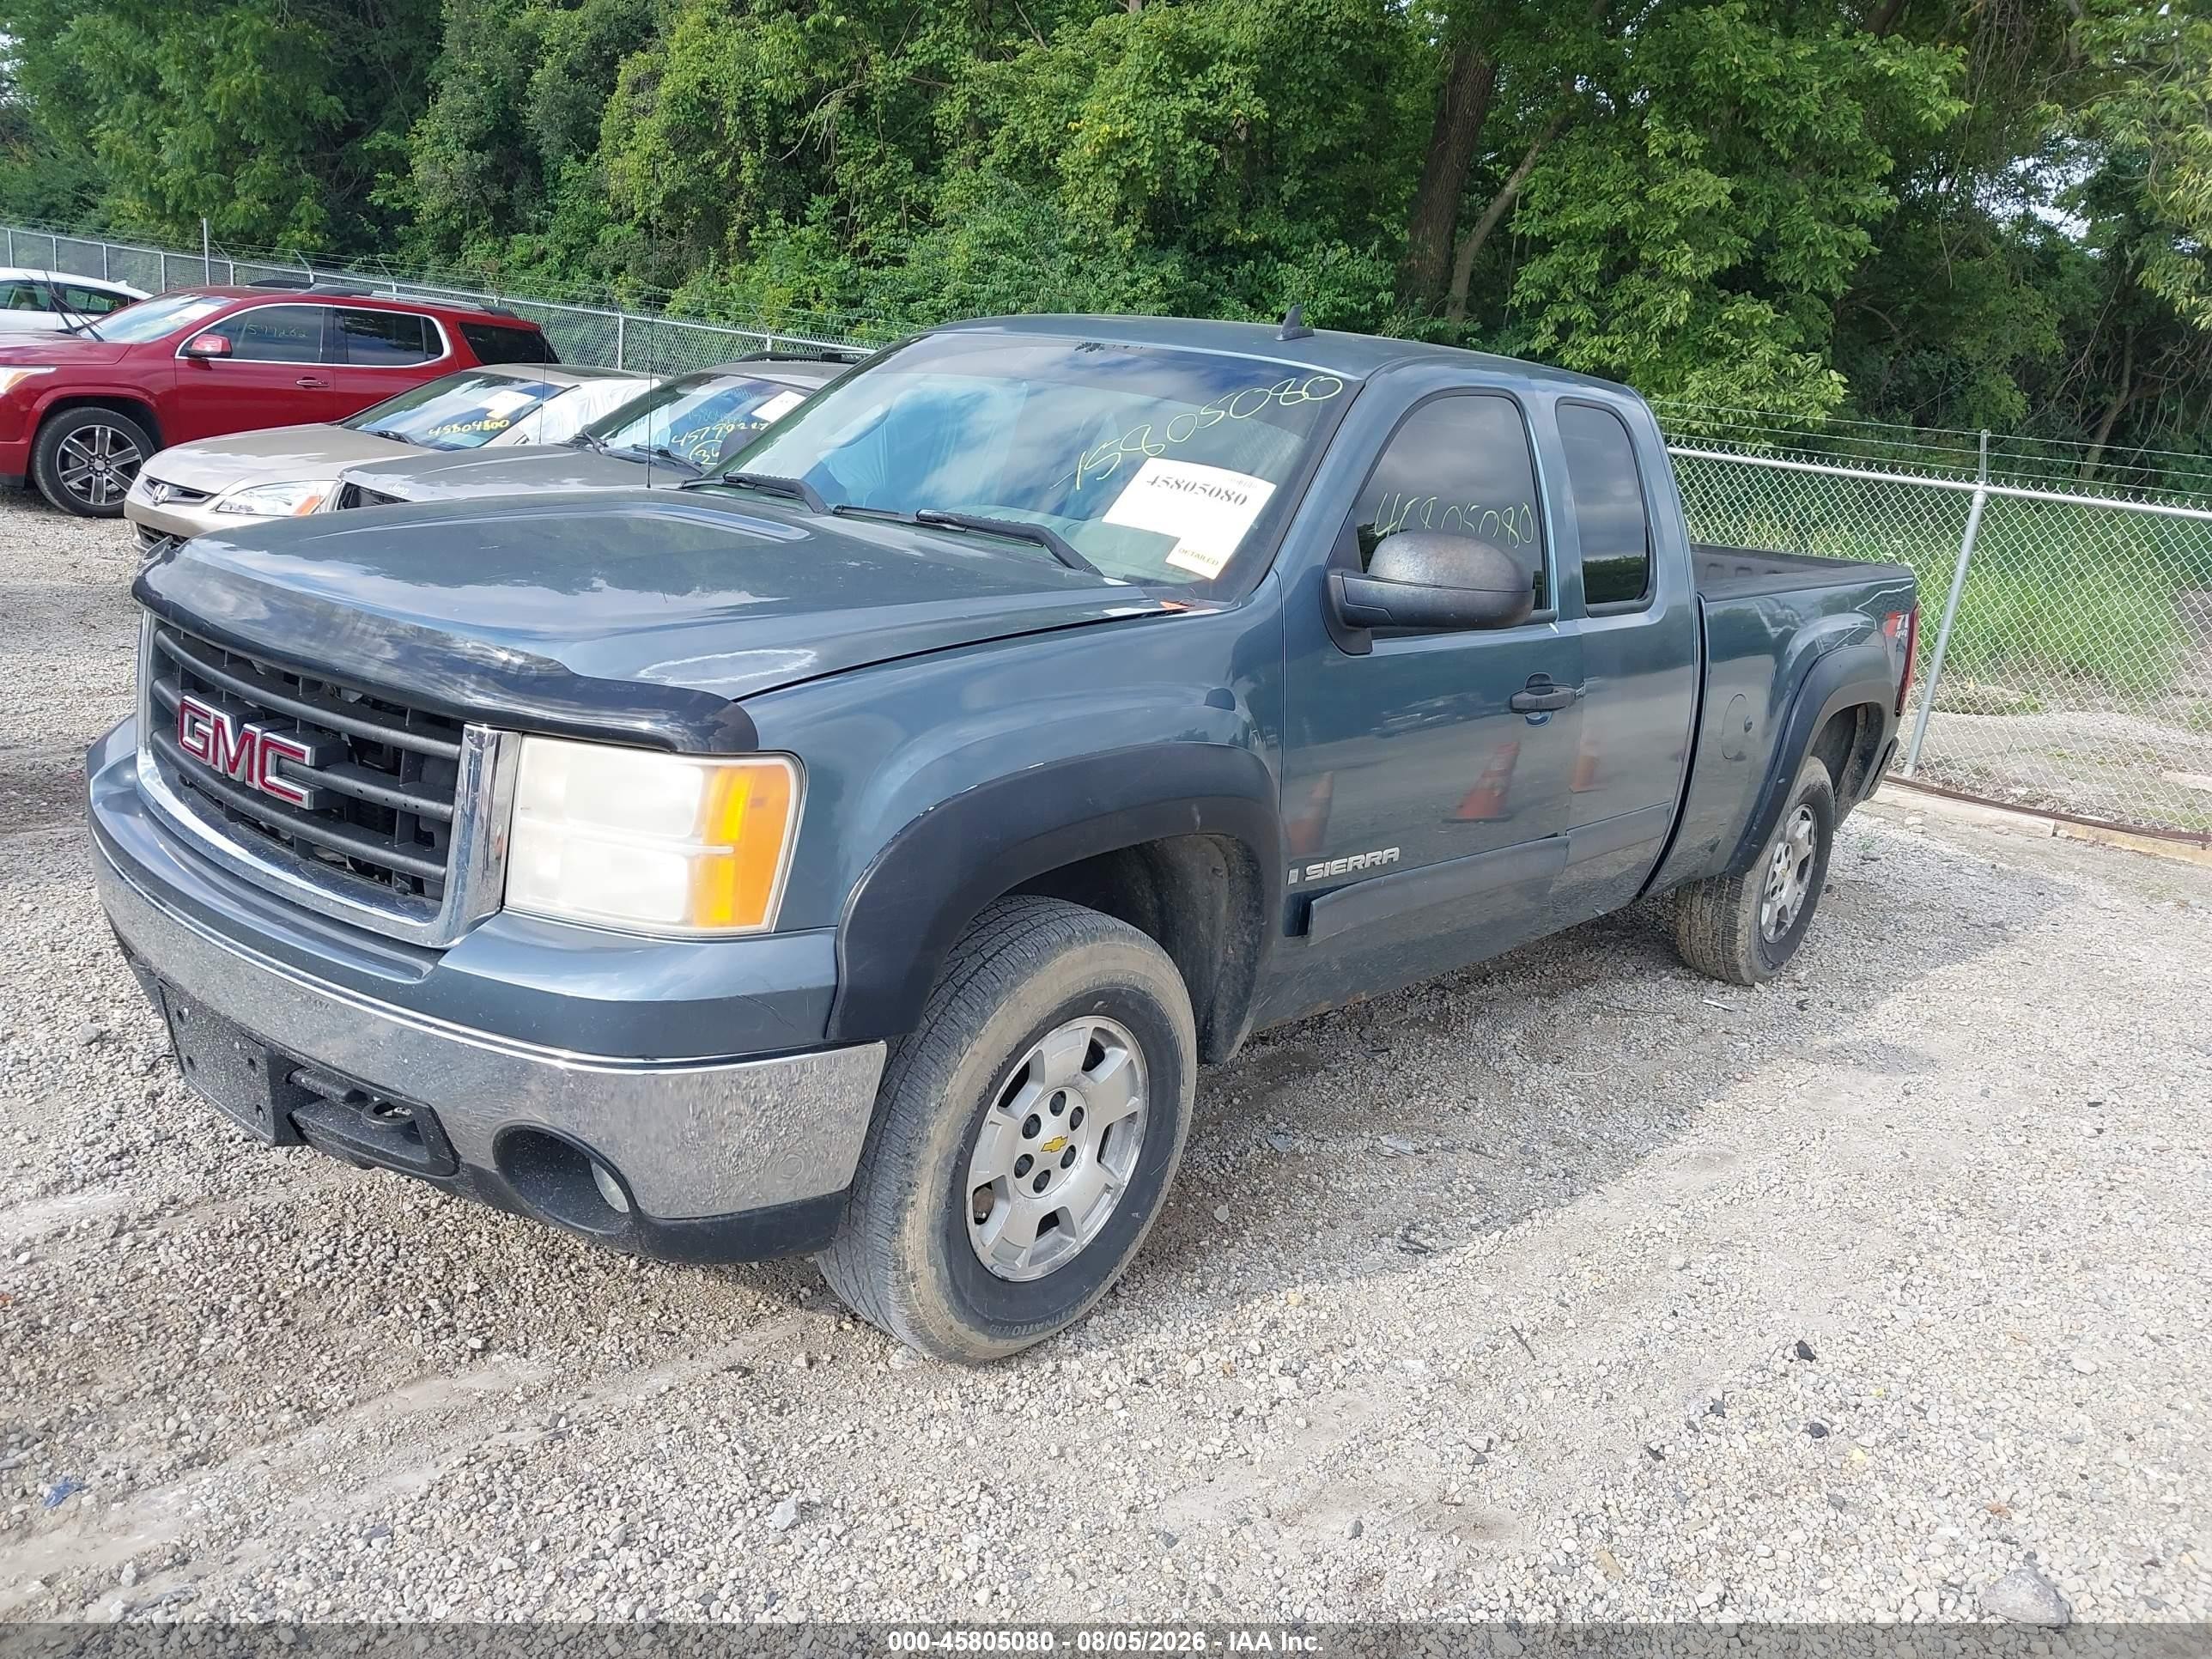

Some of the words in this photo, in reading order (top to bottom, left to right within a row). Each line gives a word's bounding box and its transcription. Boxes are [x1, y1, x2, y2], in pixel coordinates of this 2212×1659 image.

[1147, 475, 1248, 506] 45805080
[1178, 548, 1219, 566] DETAILED
[178, 695, 315, 810] GMC
[1305, 847, 1400, 881] SIERRA
